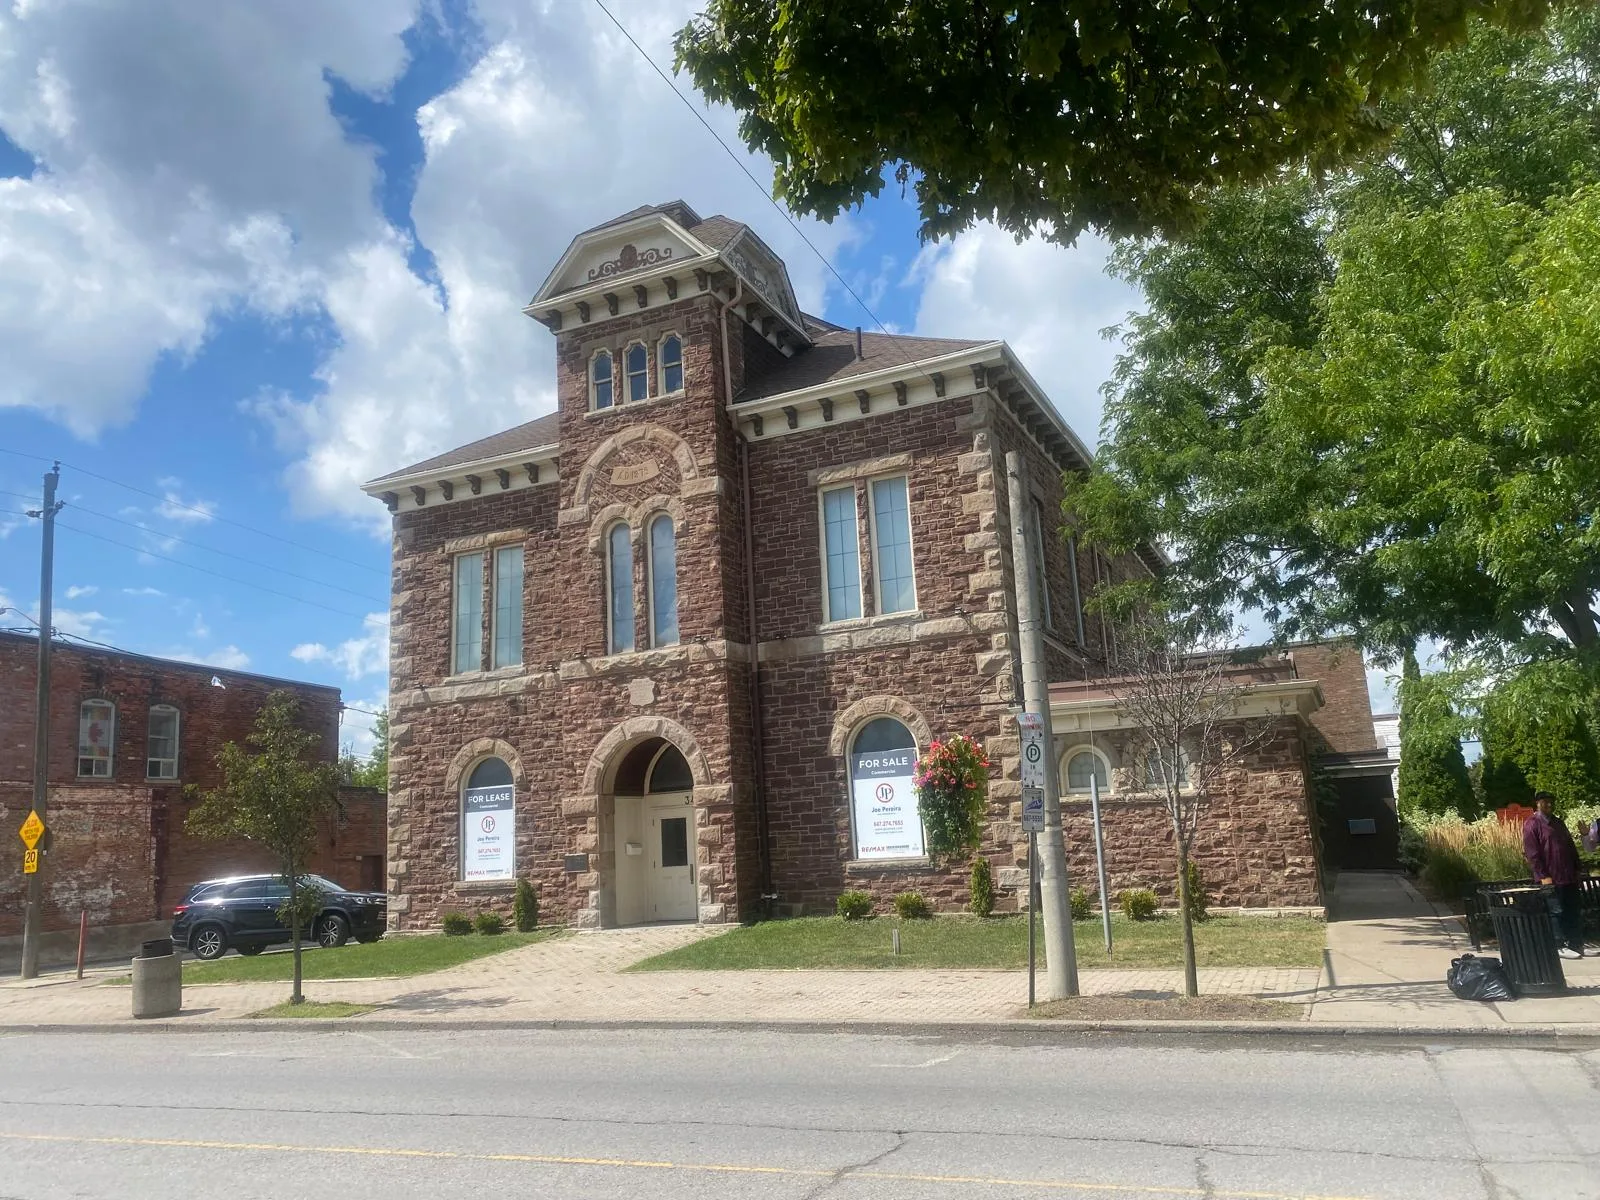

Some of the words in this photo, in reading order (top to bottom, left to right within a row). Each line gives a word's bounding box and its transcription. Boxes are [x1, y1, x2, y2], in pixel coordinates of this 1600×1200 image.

[859, 760, 880, 768] FOR
[882, 757, 908, 767] SALE
[468, 795, 484, 804] FOR
[485, 792, 510, 802] LEASE
[25, 851, 36, 863] 20
